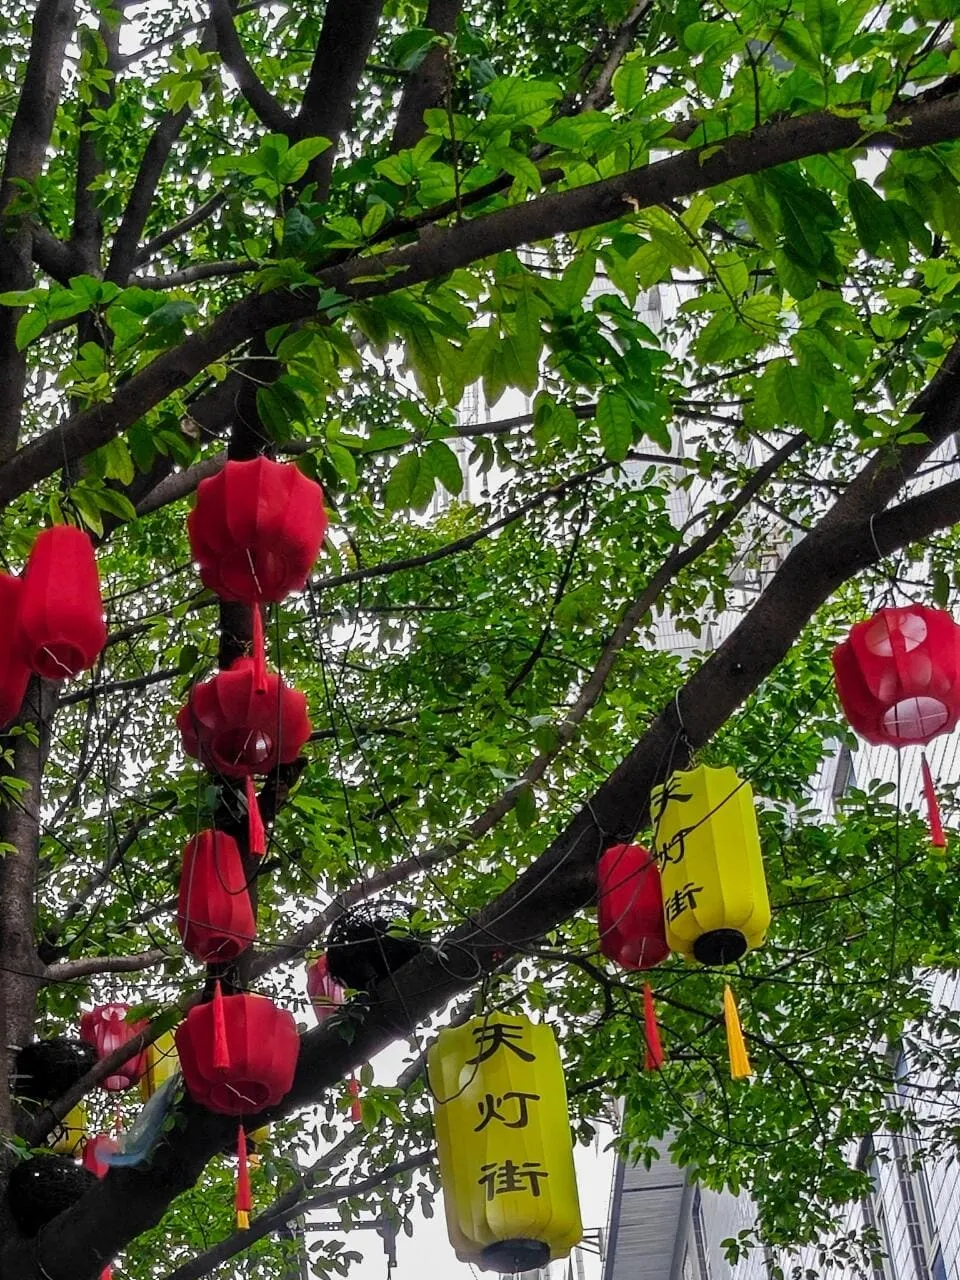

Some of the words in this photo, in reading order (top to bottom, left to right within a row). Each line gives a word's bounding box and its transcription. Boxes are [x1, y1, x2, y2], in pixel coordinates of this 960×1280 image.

[651, 776, 704, 925] 天灯街
[465, 1023, 549, 1201] 天灯街
